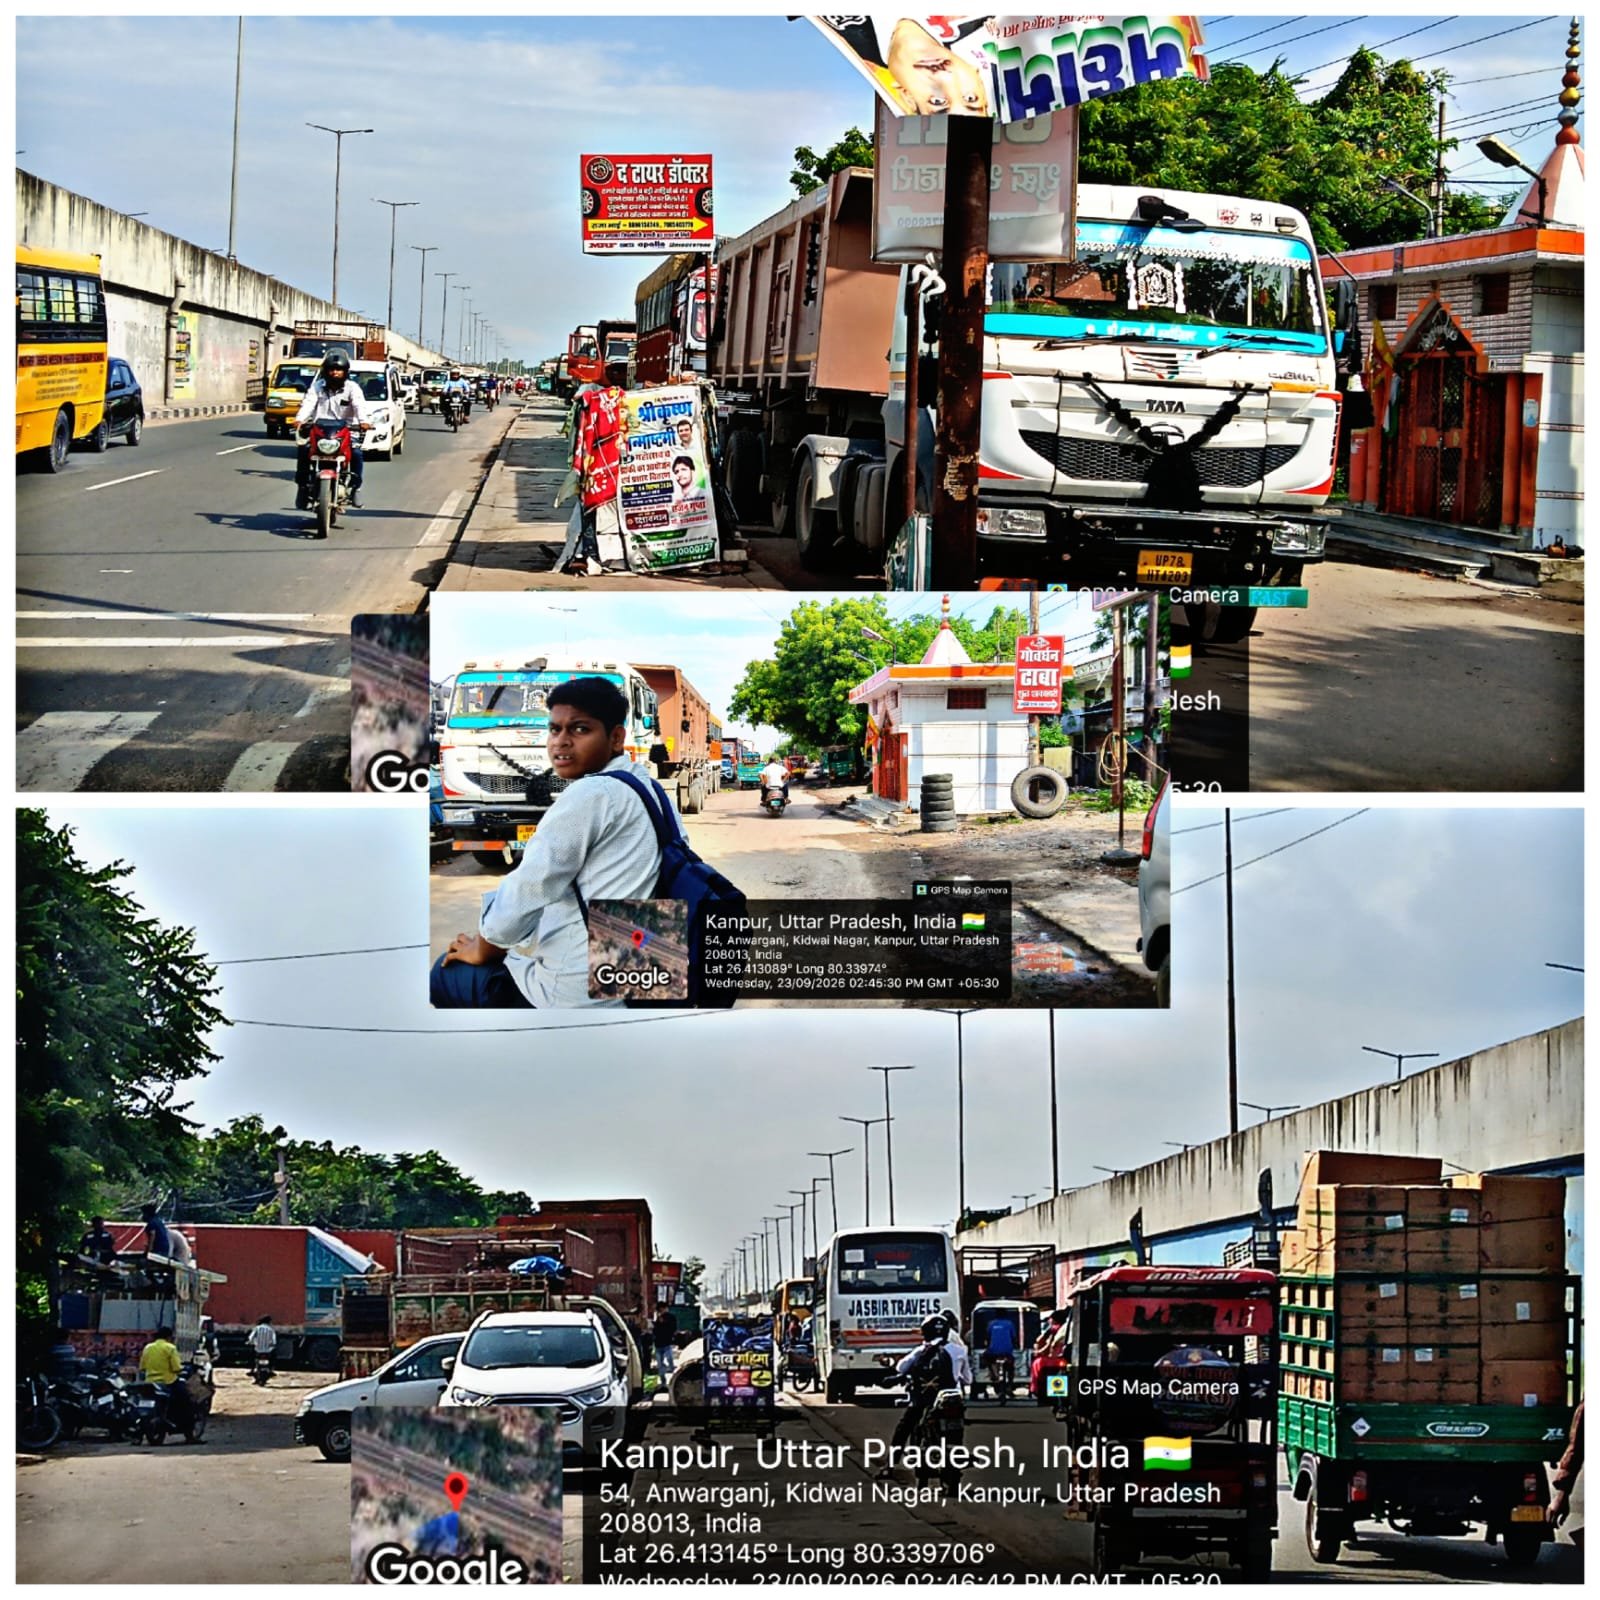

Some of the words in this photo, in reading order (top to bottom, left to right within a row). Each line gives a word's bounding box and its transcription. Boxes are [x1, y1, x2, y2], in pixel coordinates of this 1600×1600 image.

[615, 163, 628, 184] द
[630, 163, 665, 184] टायर
[667, 157, 709, 184] डॉक्टर
[1146, 399, 1185, 414] TATA
[1018, 647, 1060, 663] गोवर्धन
[1018, 668, 1059, 687] ढाबा
[848, 1299, 890, 1317] JASBIR
[890, 1298, 941, 1317] TRAVELS
